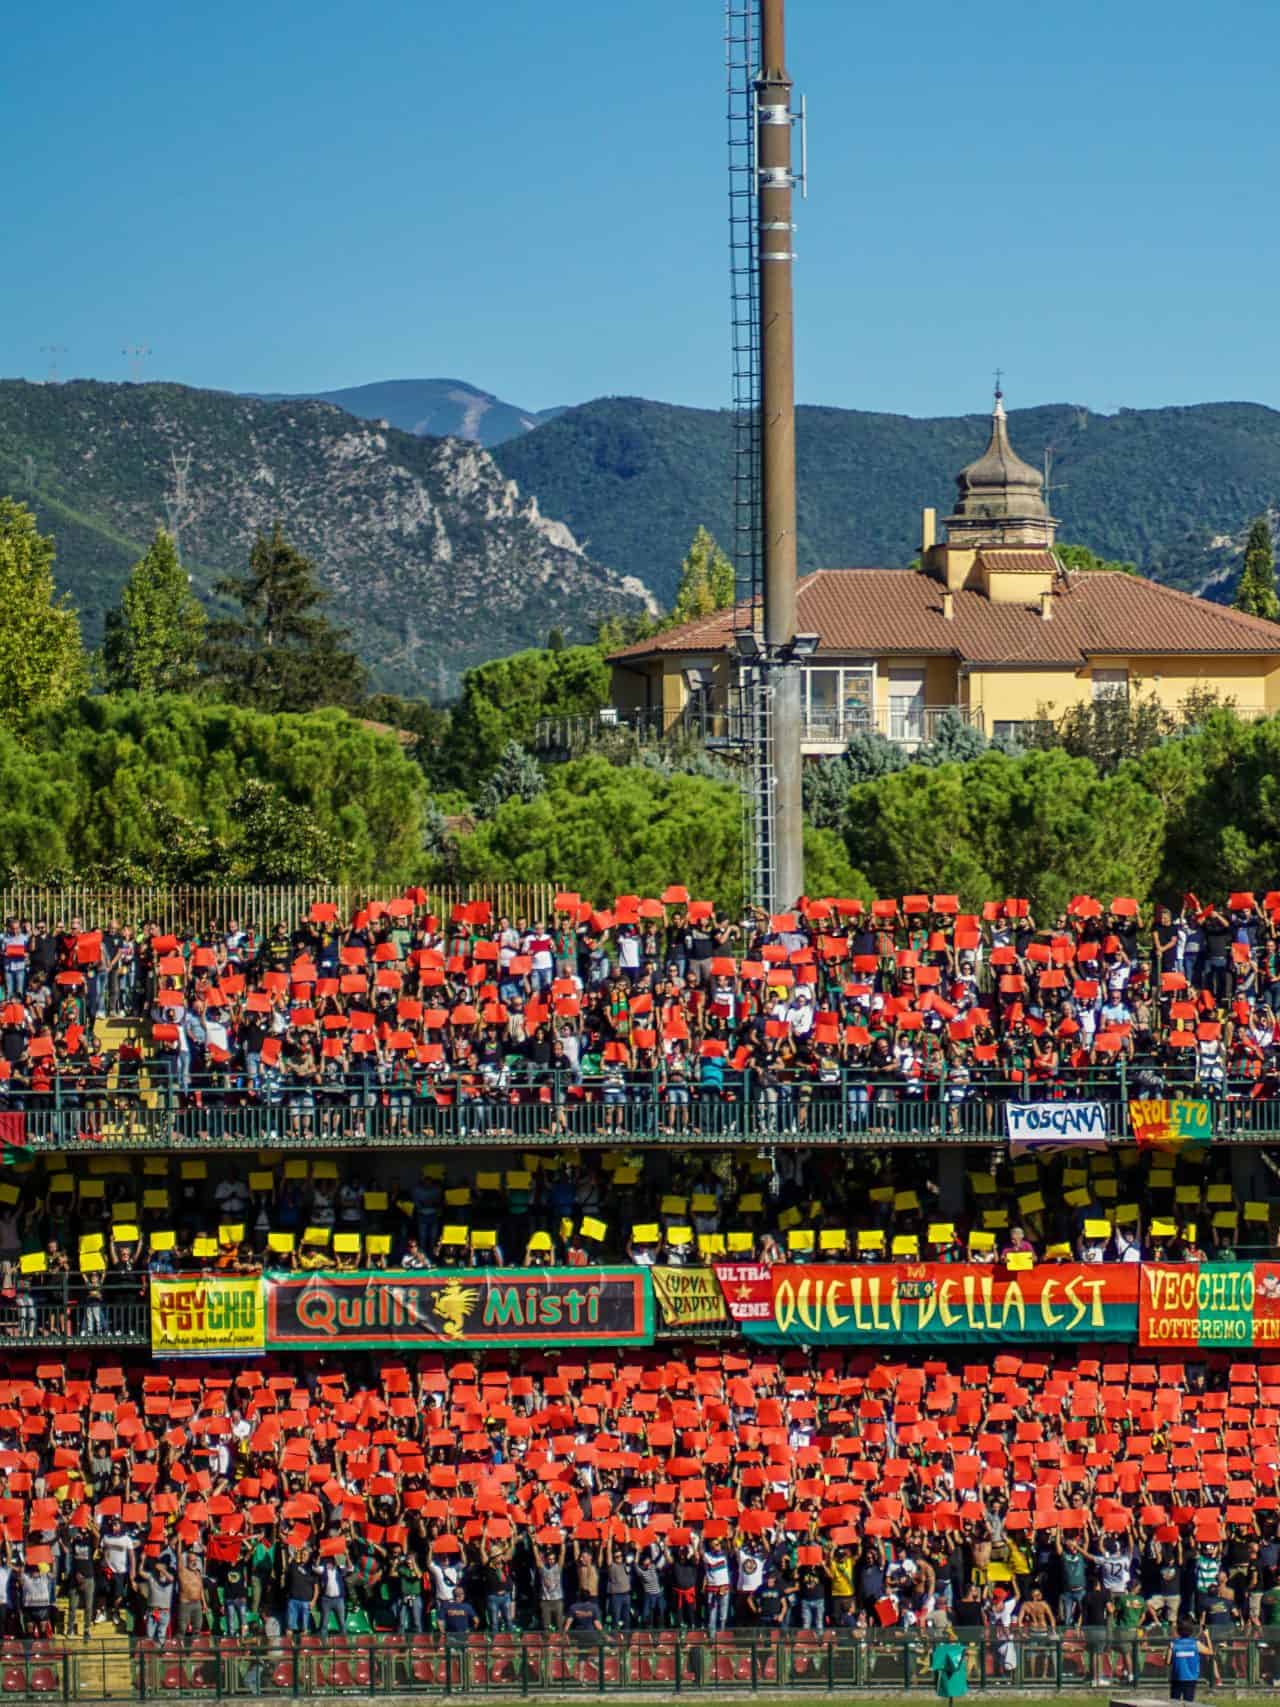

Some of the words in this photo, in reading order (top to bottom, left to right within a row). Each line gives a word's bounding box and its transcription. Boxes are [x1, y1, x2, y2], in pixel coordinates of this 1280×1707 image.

[1010, 1104, 1105, 1134] TOSCANA
[1131, 1100, 1208, 1127] SPOLETO
[159, 1288, 257, 1331] PSYCHO
[296, 1289, 418, 1334] Quilli
[483, 1286, 600, 1327] Misti
[775, 1275, 900, 1332] QUELLI
[917, 1277, 1026, 1331] DELLA
[1040, 1274, 1107, 1330] EST
[1145, 1269, 1256, 1312] VECCHIO
[1148, 1317, 1247, 1340] LOTTEREMO
